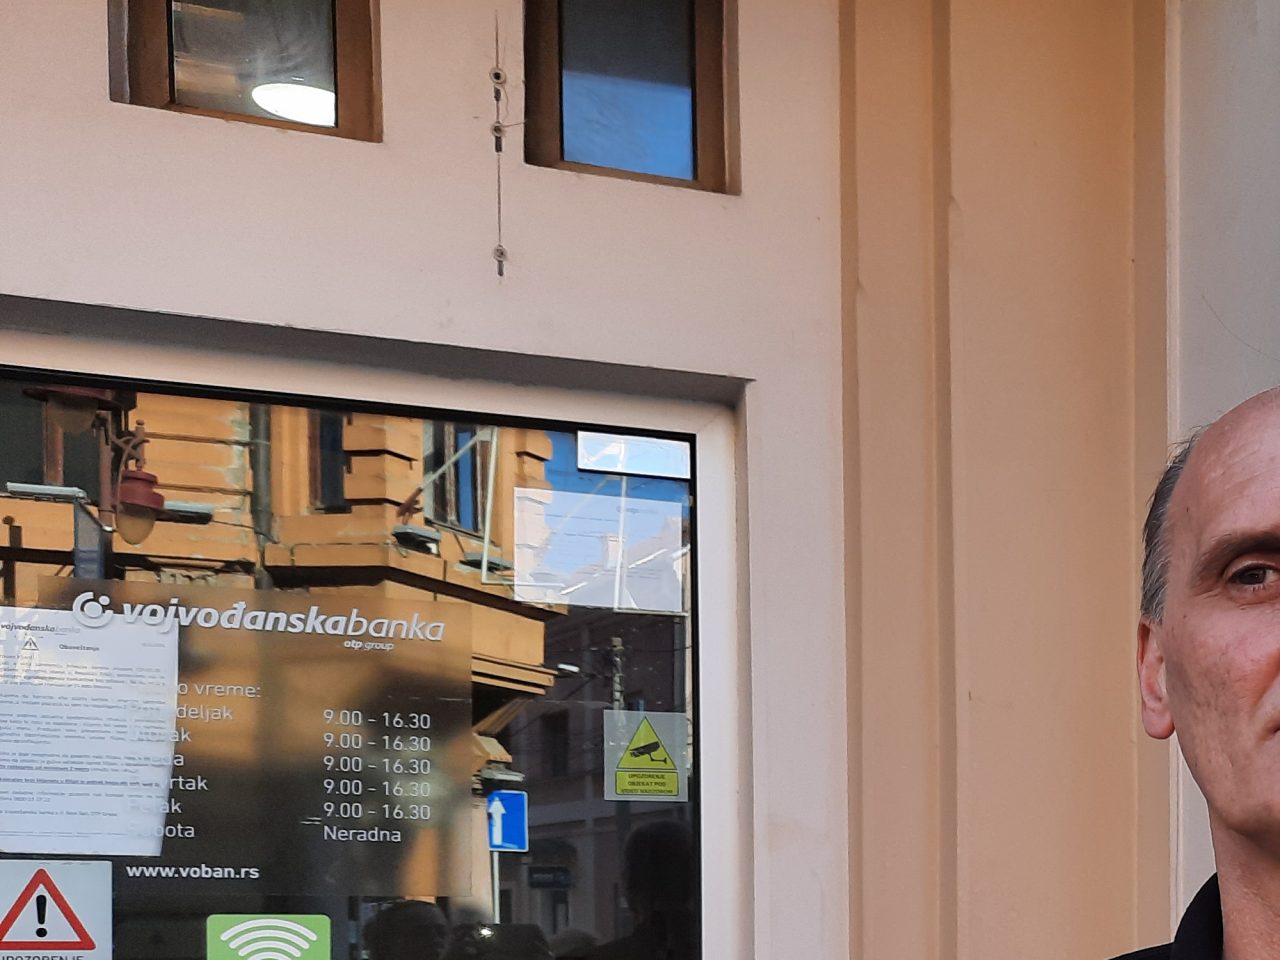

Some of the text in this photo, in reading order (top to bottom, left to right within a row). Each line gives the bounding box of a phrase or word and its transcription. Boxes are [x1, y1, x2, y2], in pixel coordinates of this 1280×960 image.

[344, 639, 395, 653] otp group
[194, 683, 261, 698] vreme:
[323, 709, 362, 726] 9.00
[382, 712, 431, 729] 16.30
[323, 732, 362, 749] 9.00
[382, 735, 431, 752] 16.30
[323, 755, 362, 772] 9.00
[382, 758, 431, 775] 16.30
[323, 779, 362, 795] 9.00
[382, 781, 431, 797] 16.30
[323, 802, 362, 818] 9.00
[382, 804, 431, 820] 16.30
[323, 825, 401, 842] Neradna
[126, 864, 260, 879] www.voban.rs
